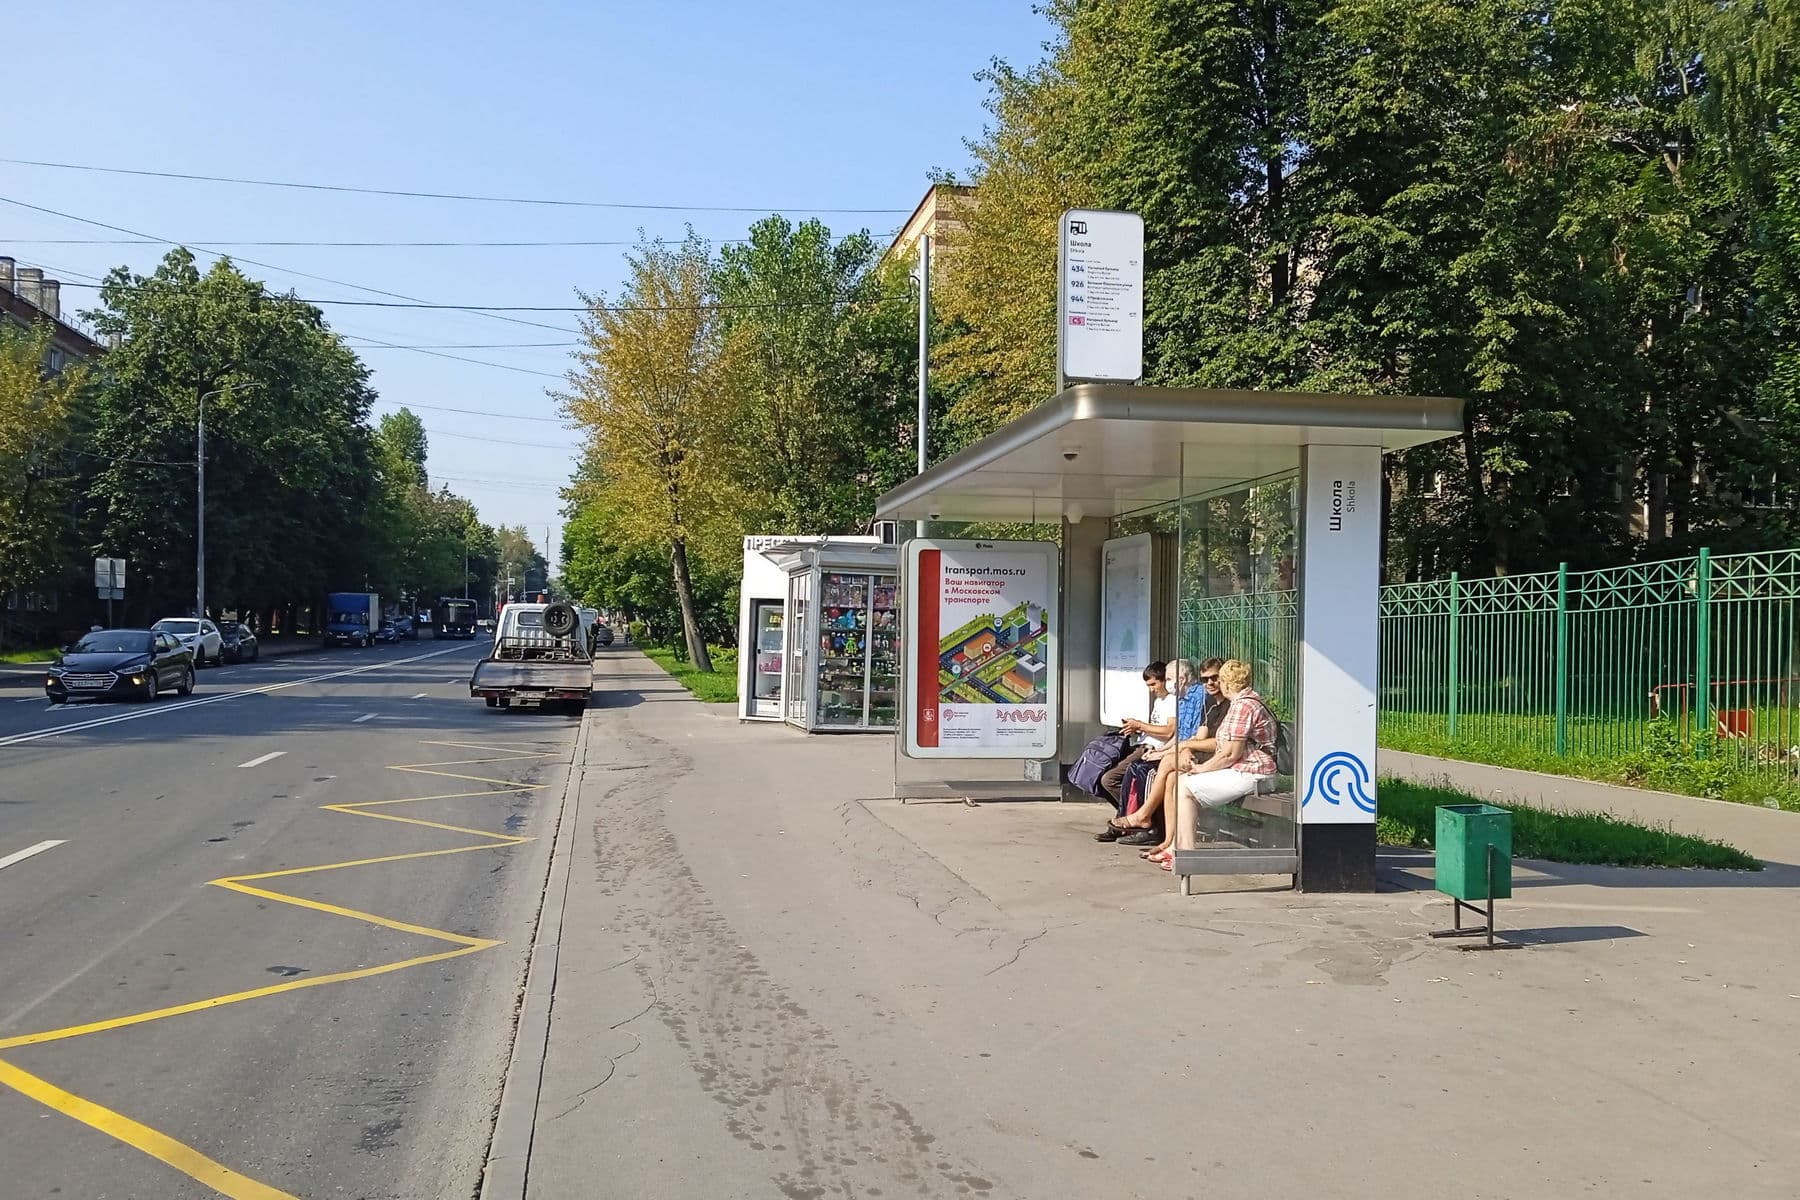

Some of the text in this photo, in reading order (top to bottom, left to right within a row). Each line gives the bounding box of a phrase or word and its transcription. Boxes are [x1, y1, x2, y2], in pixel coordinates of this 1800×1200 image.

[1347, 481, 1356, 512] Shkola
[1329, 480, 1342, 531] Школа
[945, 566, 1026, 577] transport.mos.ru
[945, 578, 1006, 588] Ваш навигатор
[951, 587, 1001, 595] Московском
[944, 597, 991, 605] транспорте
